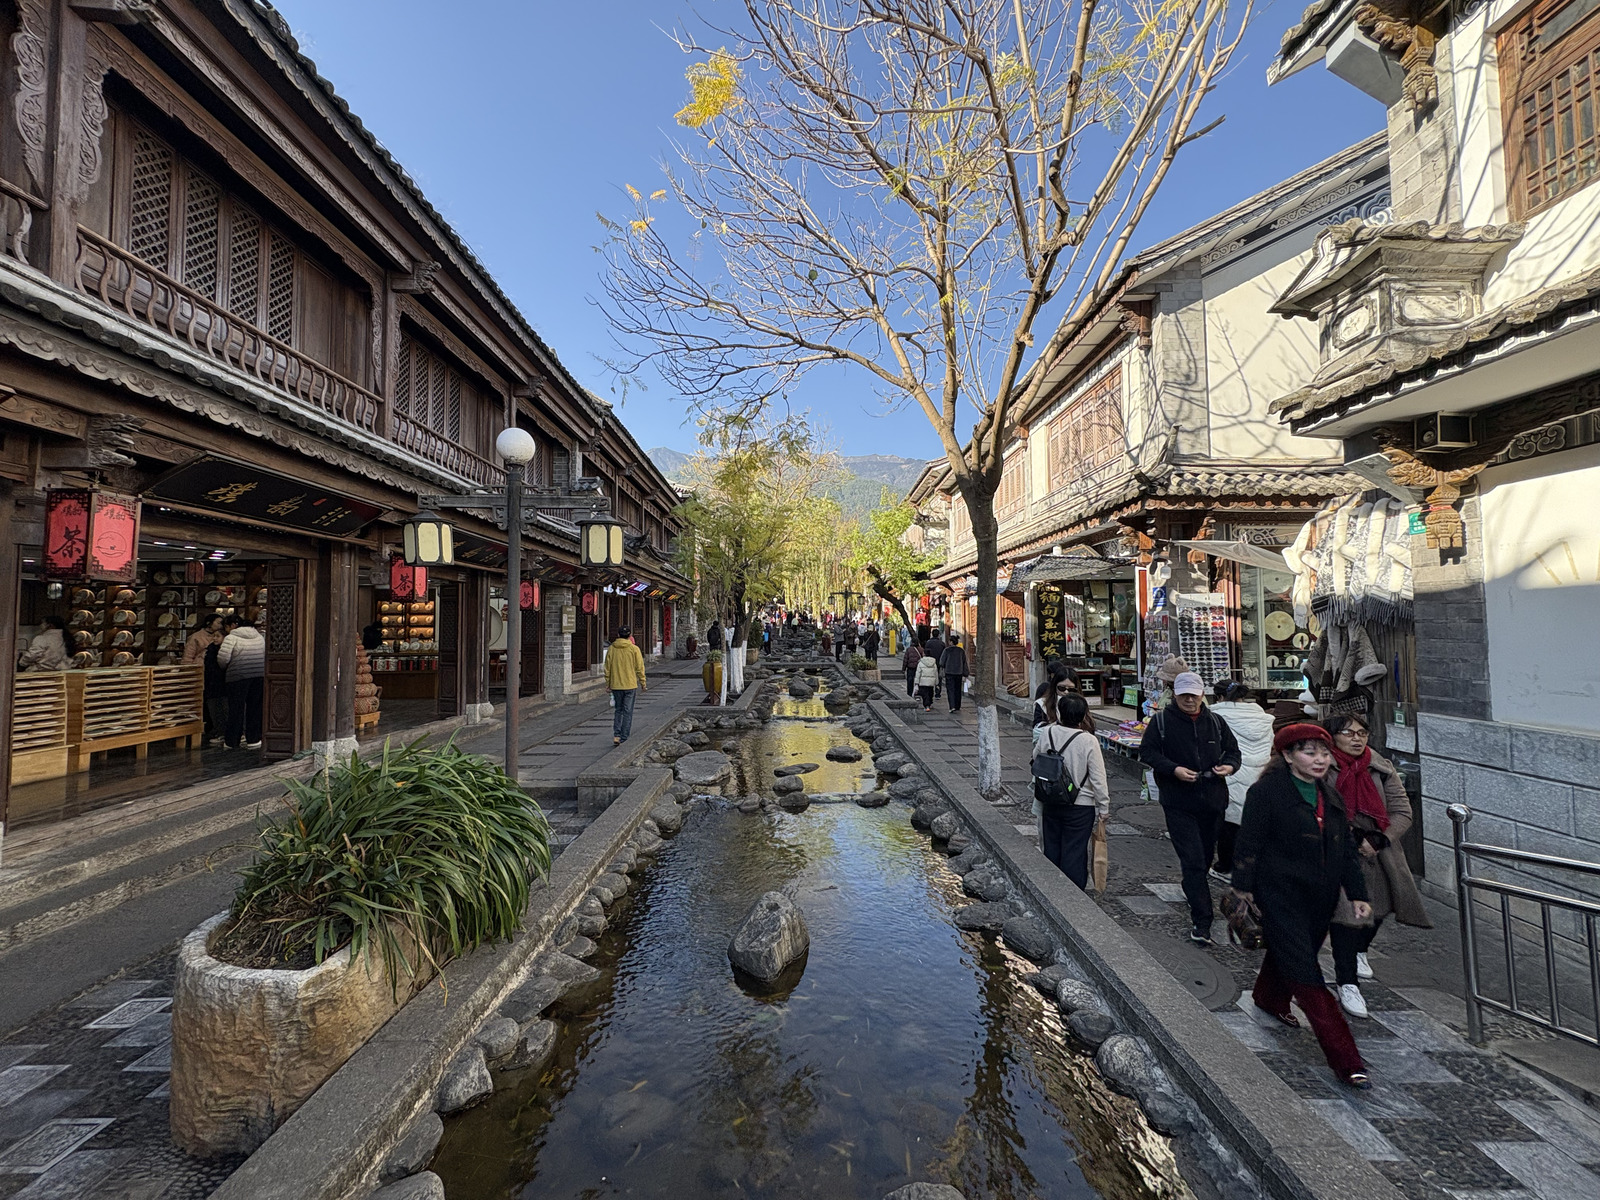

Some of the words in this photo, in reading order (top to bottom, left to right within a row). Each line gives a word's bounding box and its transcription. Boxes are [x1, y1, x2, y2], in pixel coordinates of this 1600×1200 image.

[51, 524, 87, 558] 茶
[394, 573, 414, 592] 茶
[1039, 591, 1064, 657] 缅甸玉批发
[1081, 678, 1095, 692] 玉
